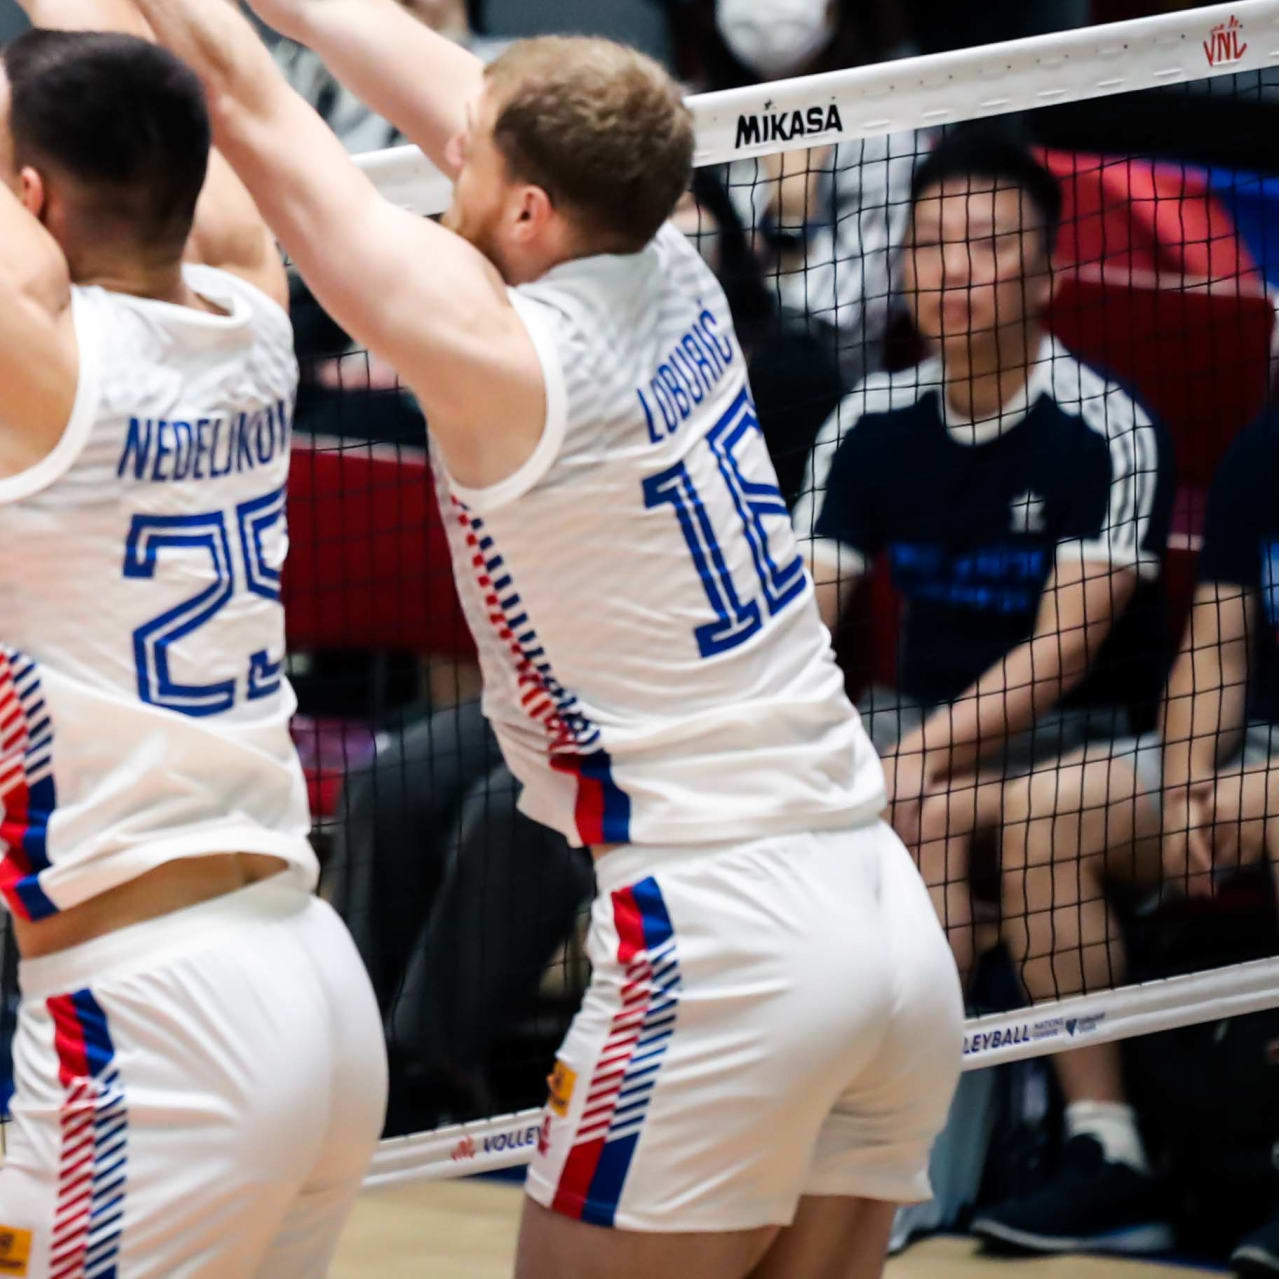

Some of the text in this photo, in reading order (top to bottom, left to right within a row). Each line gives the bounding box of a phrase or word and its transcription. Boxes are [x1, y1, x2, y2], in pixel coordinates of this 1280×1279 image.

[1203, 14, 1248, 67] VNL
[735, 100, 843, 149] MIKASA
[122, 487, 286, 717] 25
